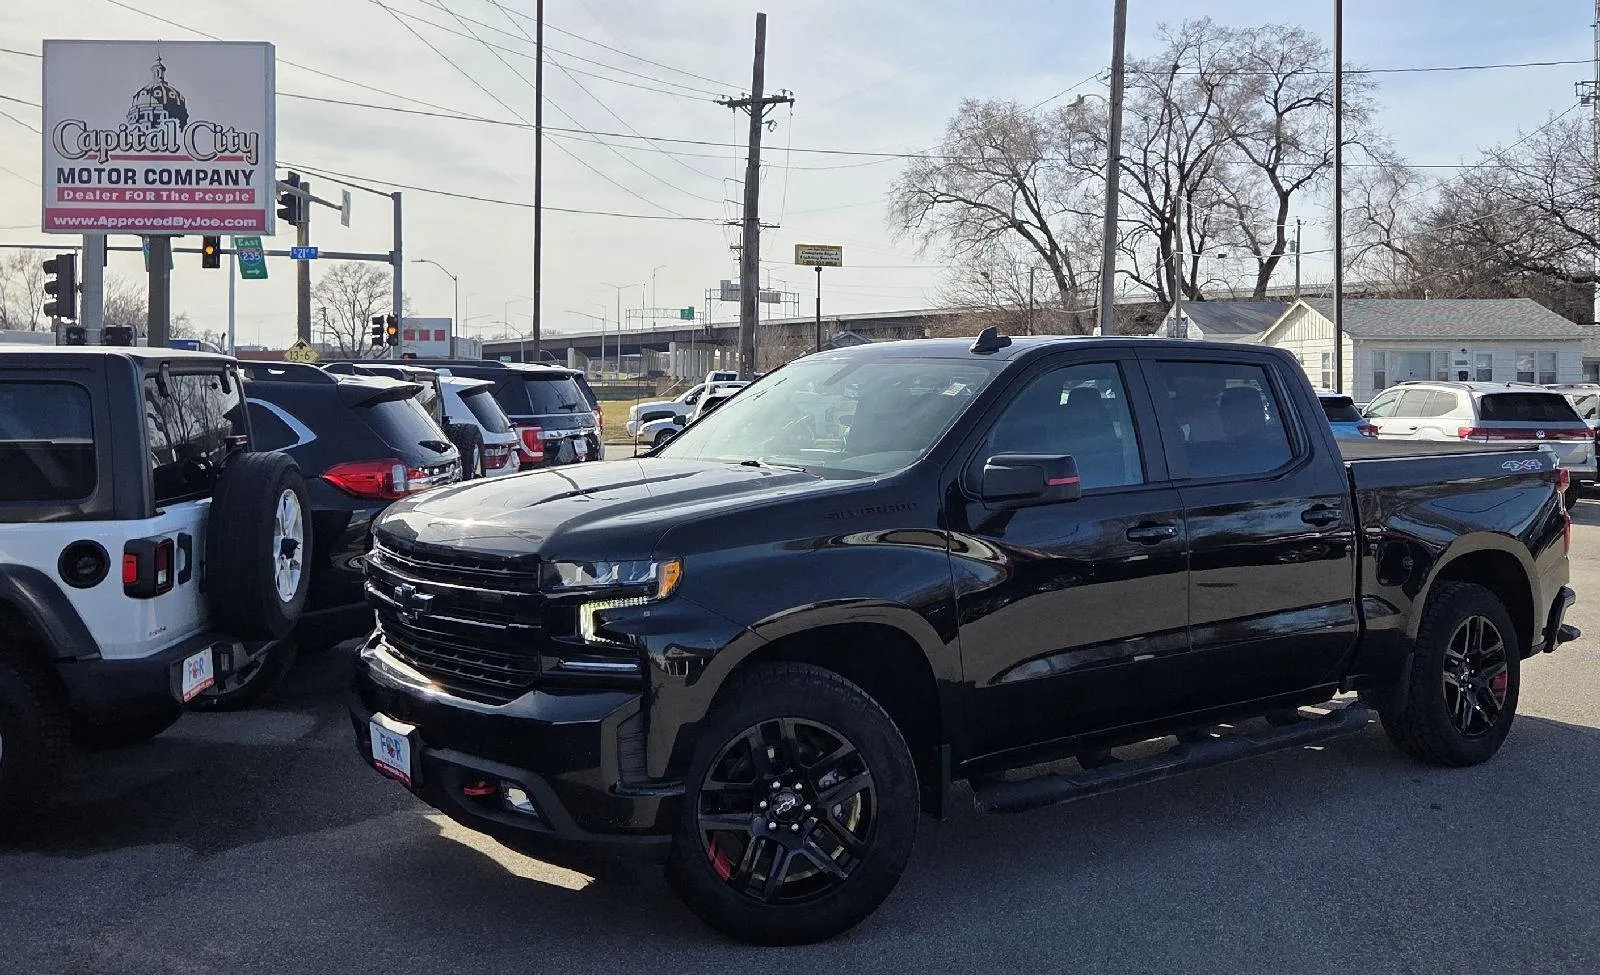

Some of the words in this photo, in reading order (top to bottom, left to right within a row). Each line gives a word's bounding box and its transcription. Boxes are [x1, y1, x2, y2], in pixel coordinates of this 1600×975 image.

[53, 118, 180, 164] Capital
[184, 120, 259, 165] City
[56, 167, 137, 185] MOTOR
[144, 168, 254, 186] COMPANY
[64, 190, 119, 200] Dealer
[125, 191, 155, 200] FOR
[160, 191, 189, 201] The
[195, 192, 249, 203] People
[54, 215, 257, 229] www.ApprovedByJoe.com
[238, 239, 259, 247] EAST
[242, 252, 260, 261] 235
